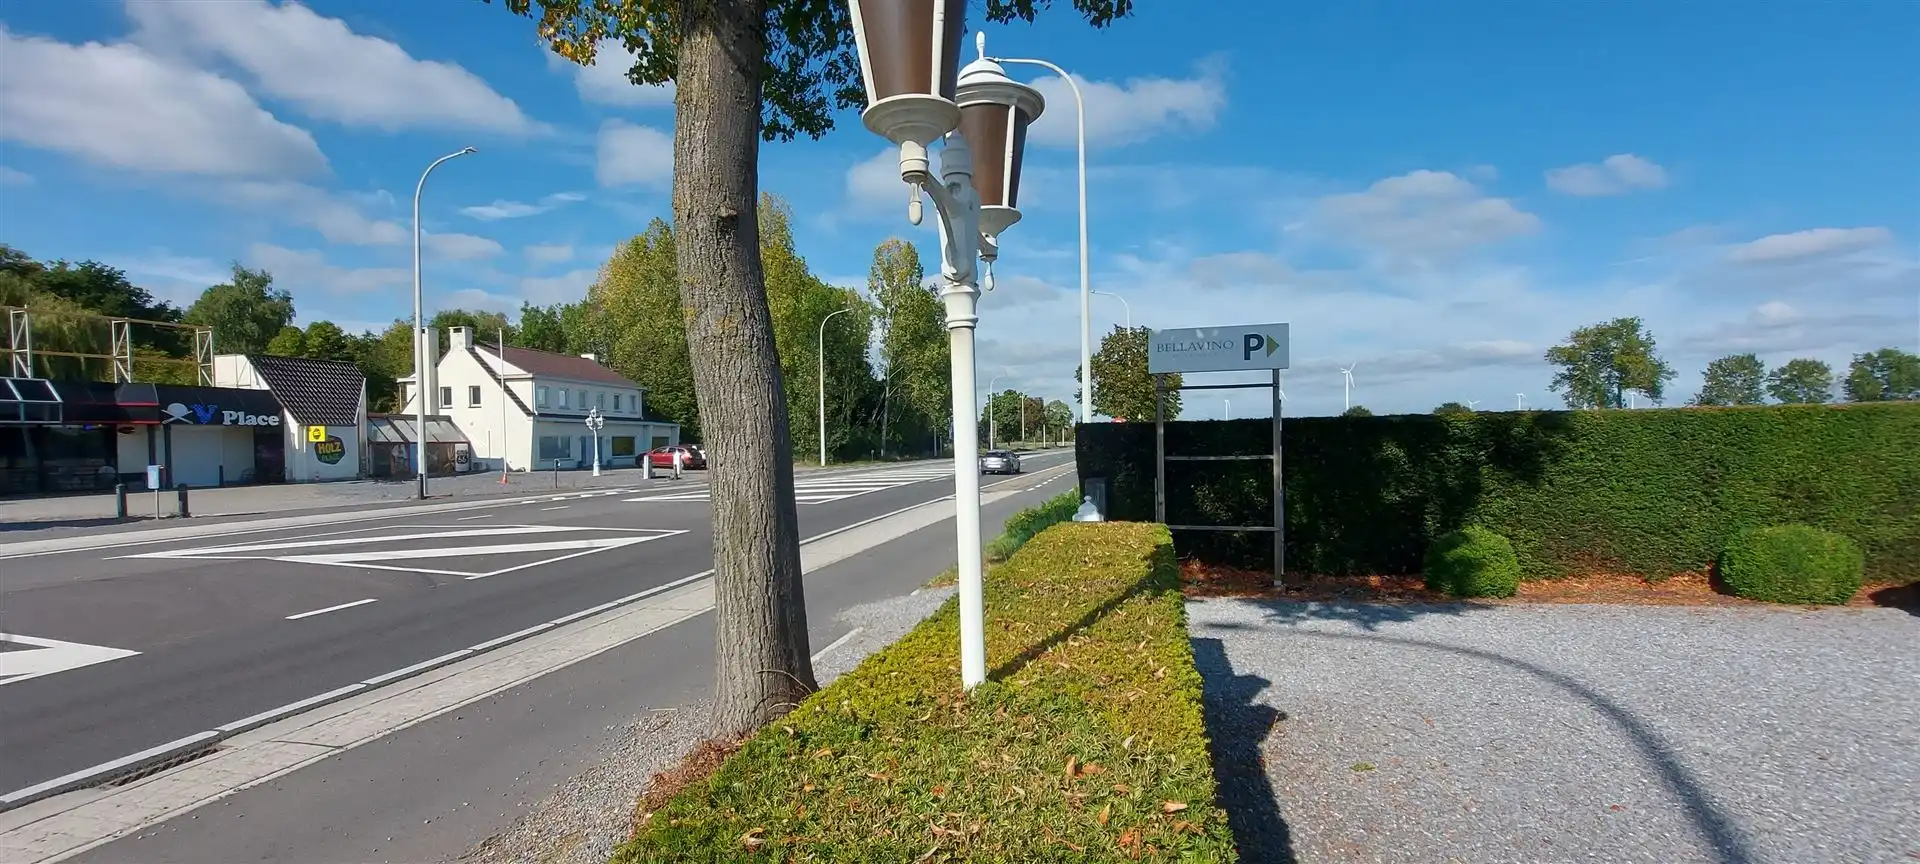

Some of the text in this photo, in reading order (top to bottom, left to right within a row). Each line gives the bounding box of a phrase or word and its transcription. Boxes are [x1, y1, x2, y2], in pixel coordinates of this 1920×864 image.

[1157, 333, 1264, 360] BELLAVINO P
[221, 410, 280, 426] Place
[317, 441, 342, 454] HOLZ
